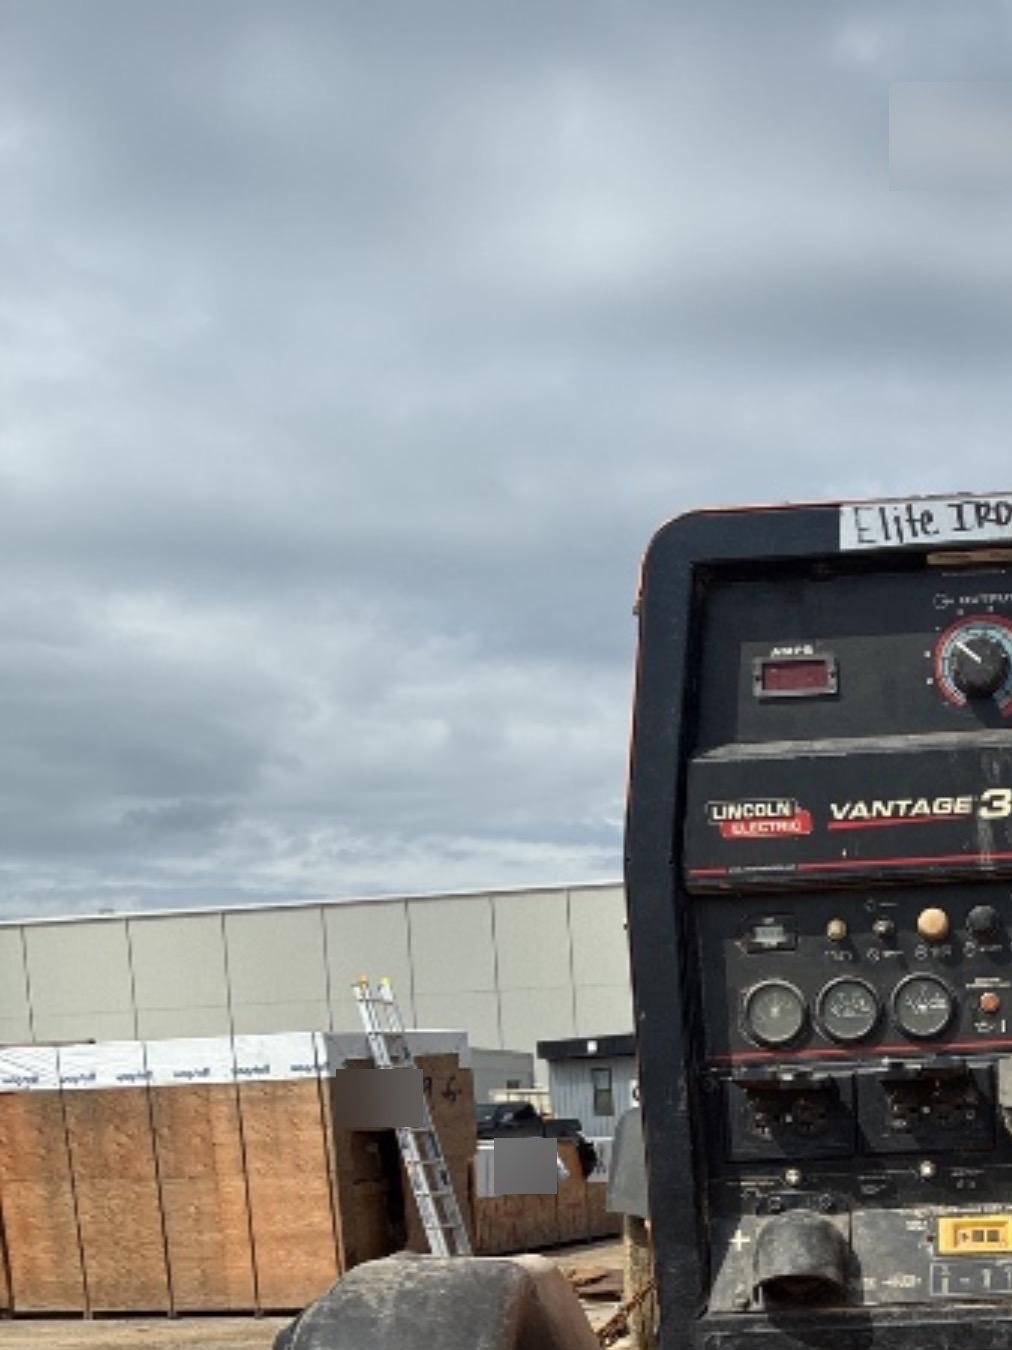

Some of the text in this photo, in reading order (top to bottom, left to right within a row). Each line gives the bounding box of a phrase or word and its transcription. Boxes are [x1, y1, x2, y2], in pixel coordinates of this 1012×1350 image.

[855, 503, 940, 544] Elite
[712, 802, 791, 820] LINCOLN
[830, 796, 973, 820] VANTAGE
[731, 821, 802, 835] ELECTRIC
